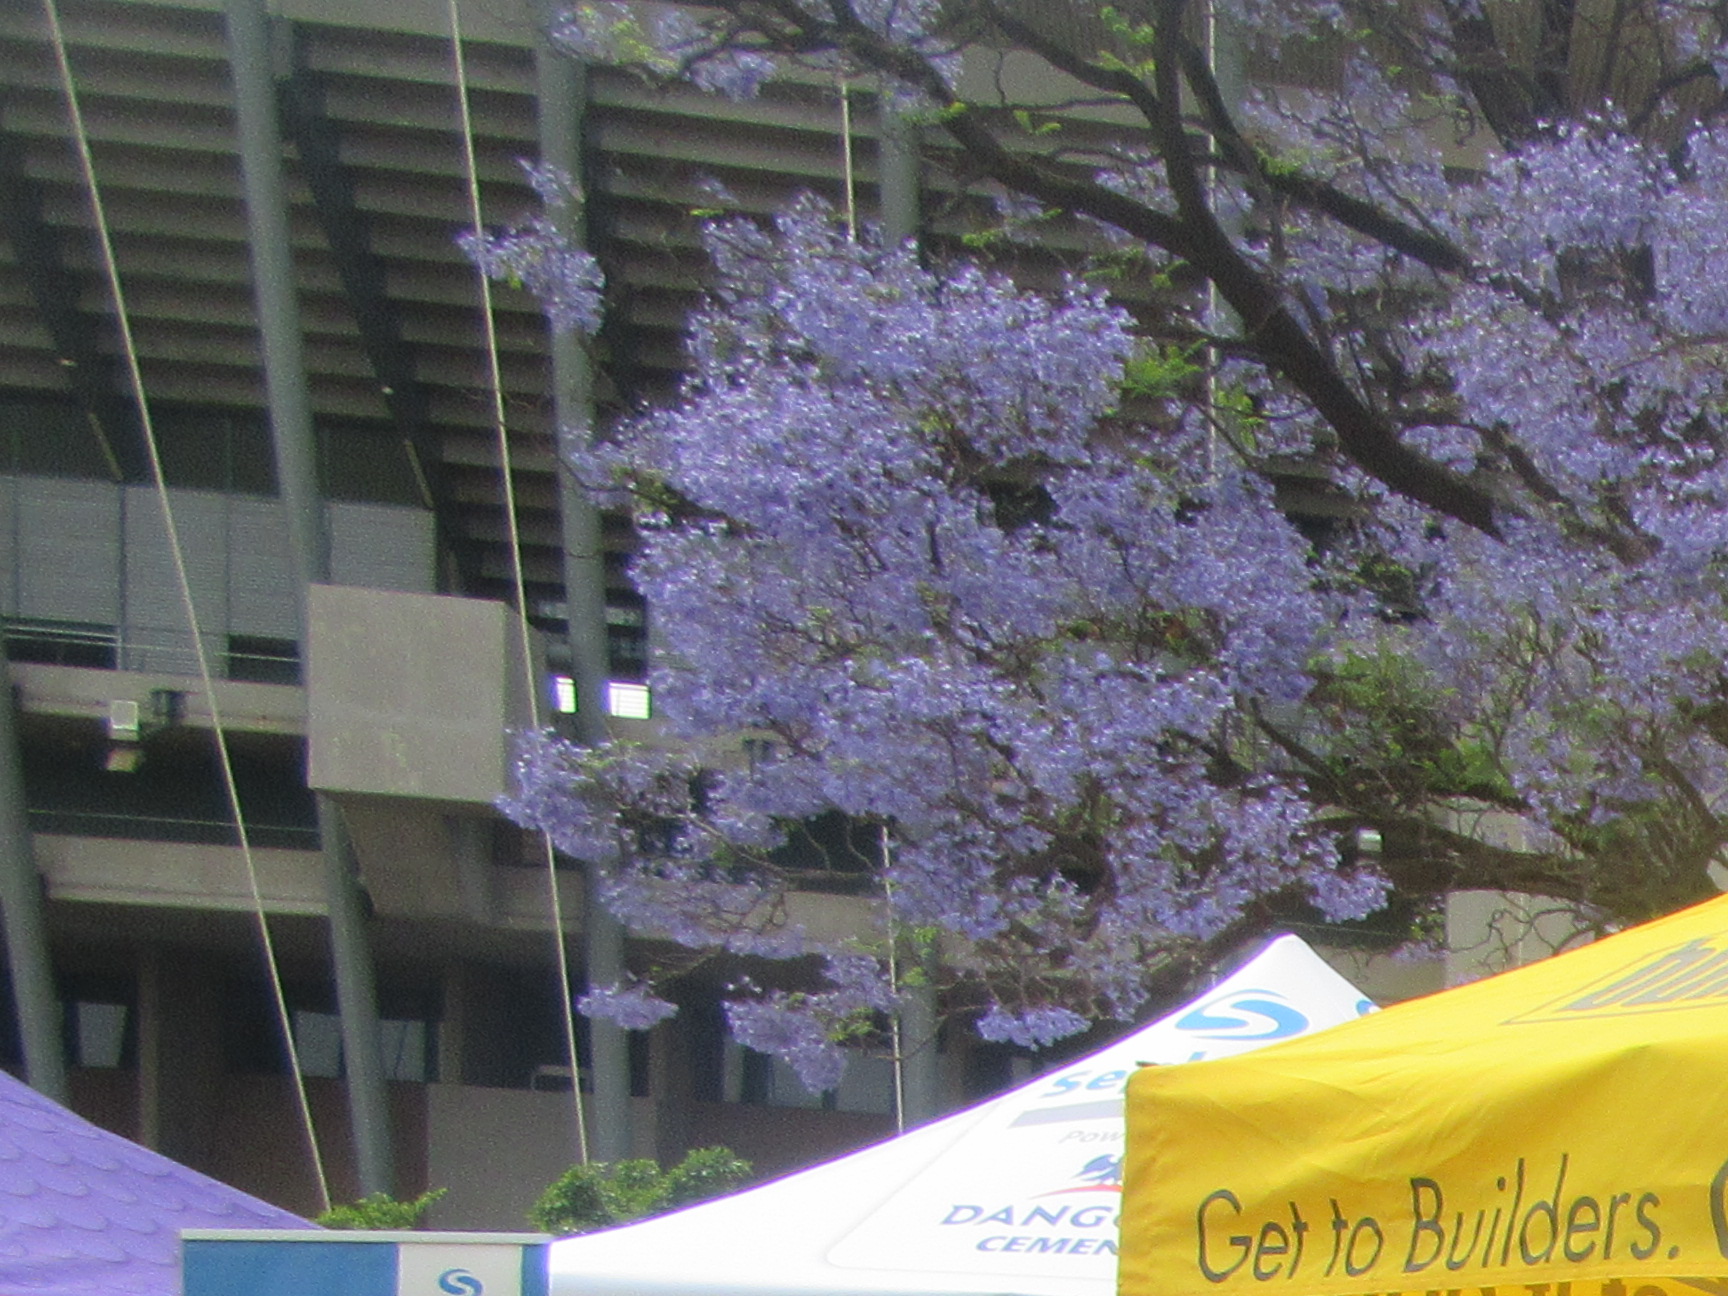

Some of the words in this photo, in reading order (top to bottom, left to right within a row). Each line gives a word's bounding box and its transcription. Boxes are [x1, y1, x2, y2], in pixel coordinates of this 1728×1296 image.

[1197, 1189, 1309, 1284] Get
[1325, 1198, 1385, 1278] to
[1404, 1155, 1682, 1275] Builders.
